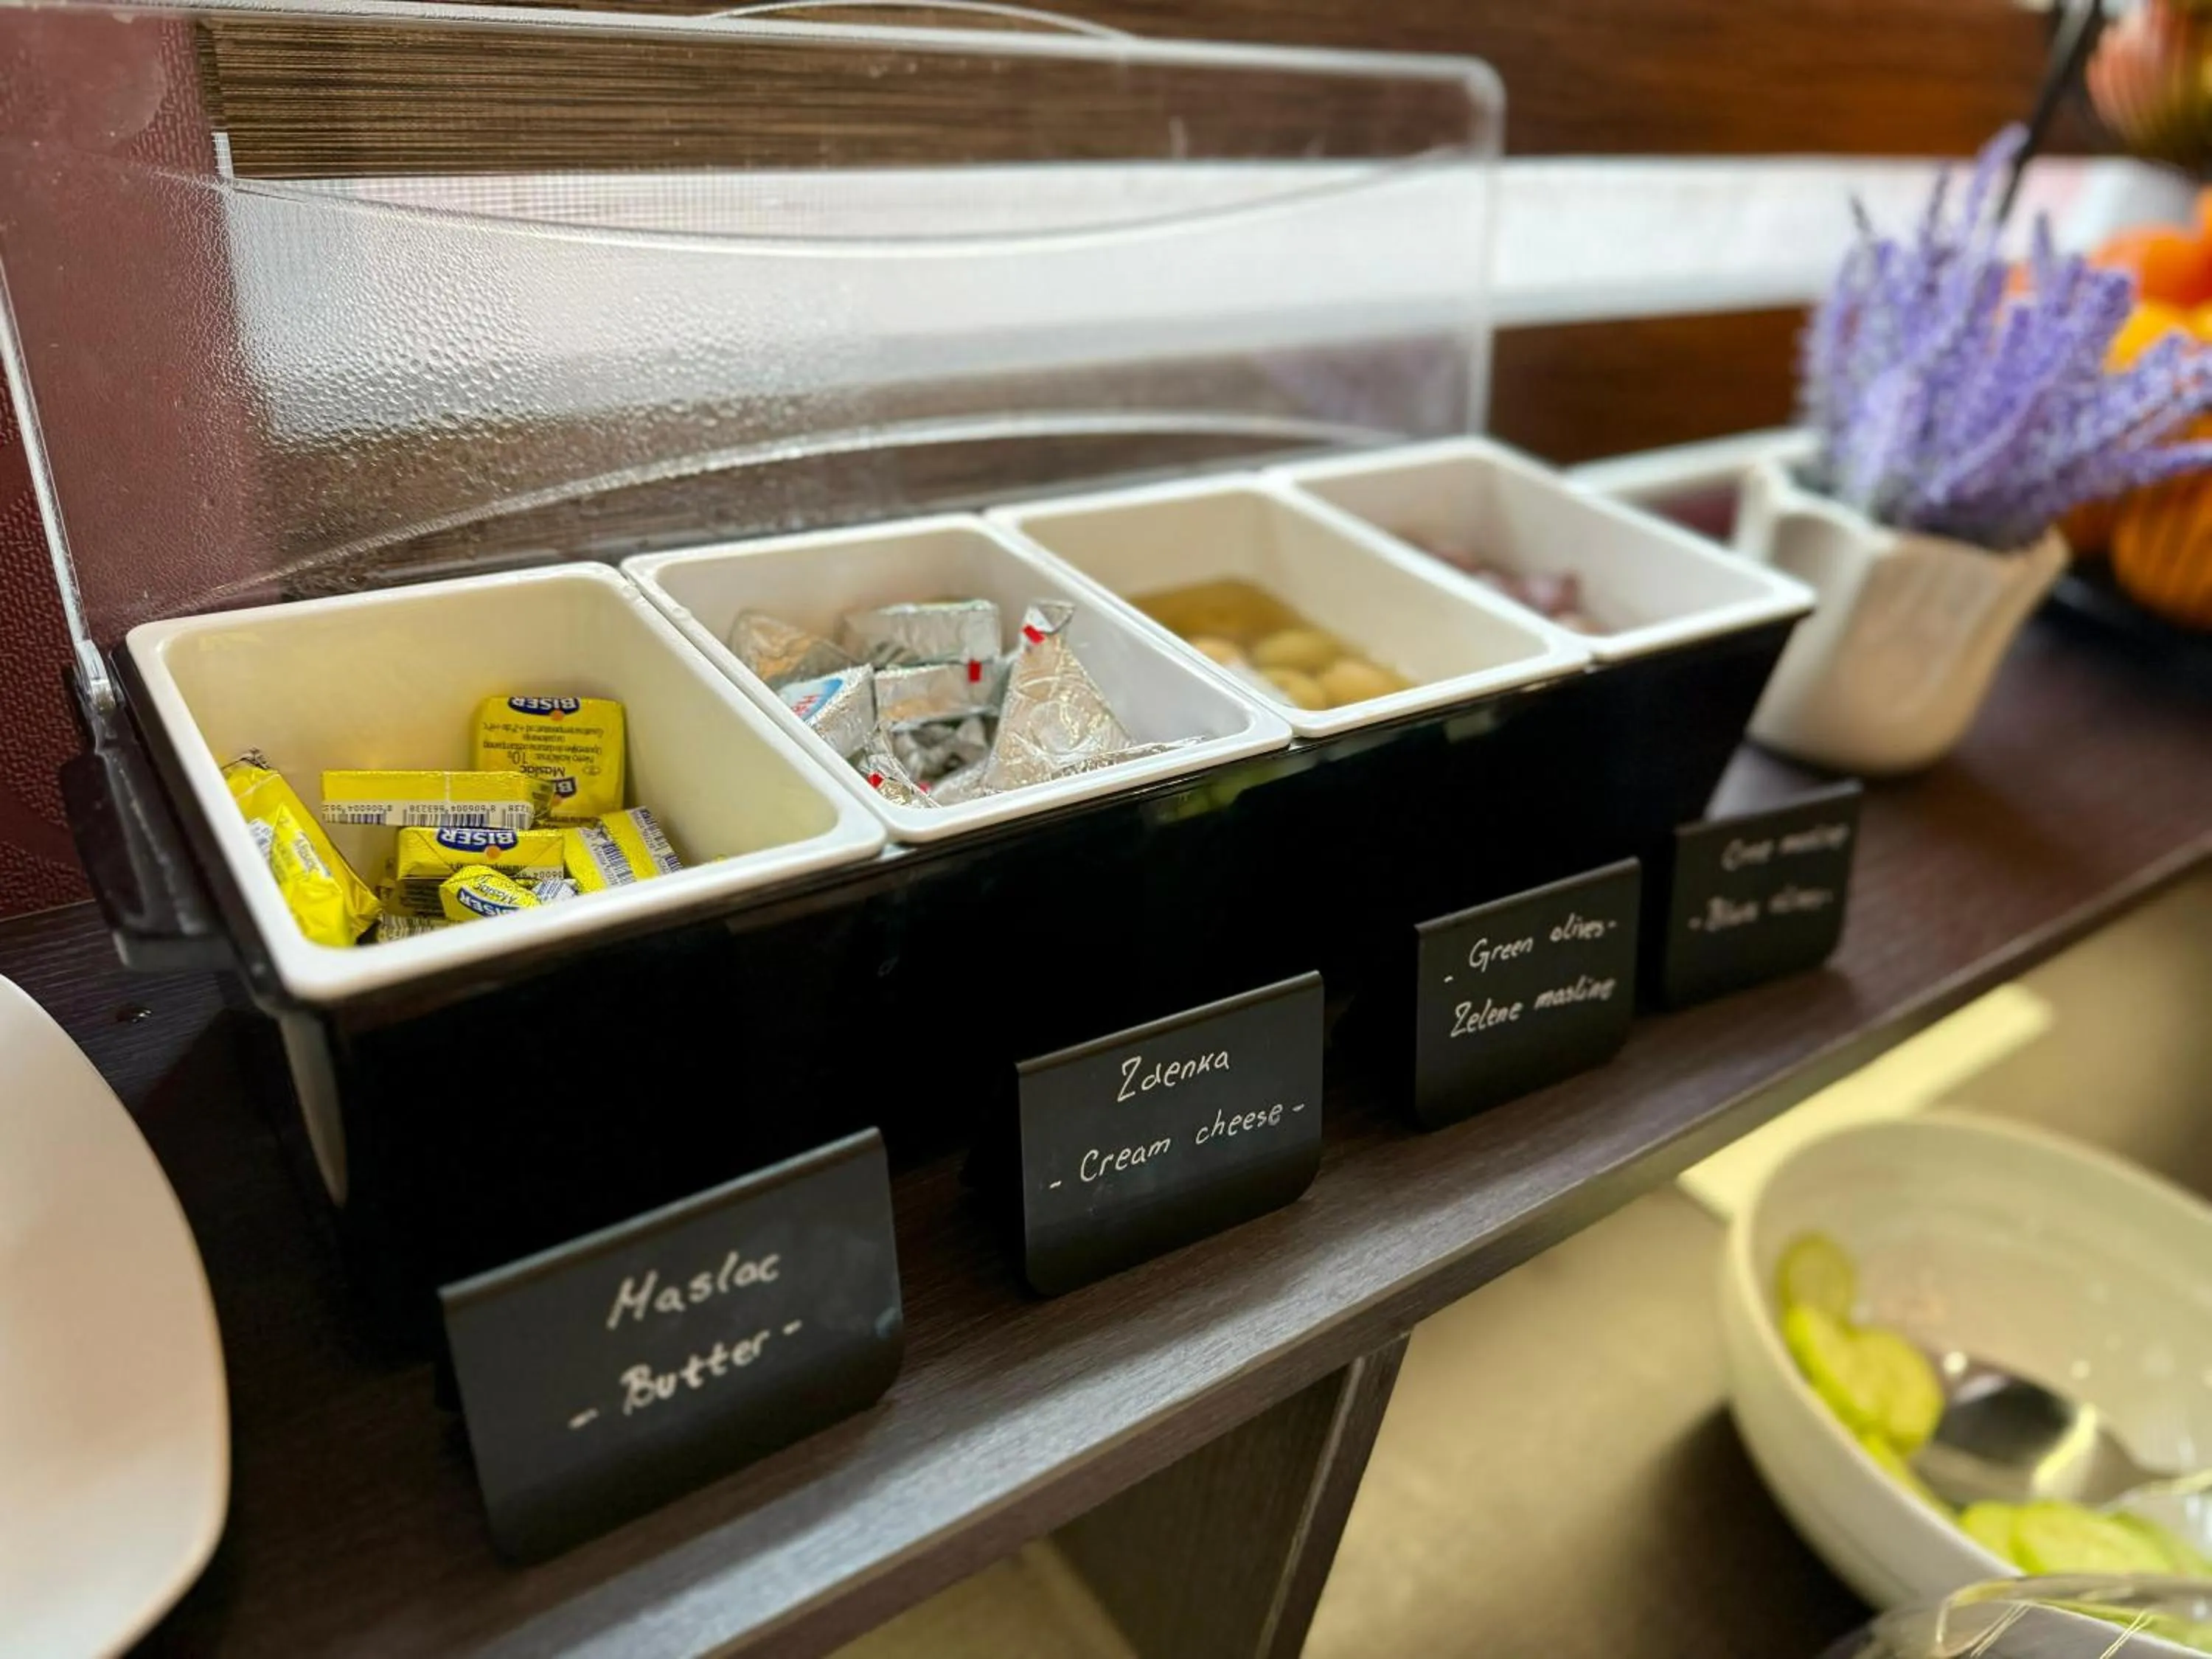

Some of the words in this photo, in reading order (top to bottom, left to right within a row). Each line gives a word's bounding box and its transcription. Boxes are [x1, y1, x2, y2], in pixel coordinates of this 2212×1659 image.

[440, 829, 515, 845] BISER
[1468, 937, 1534, 973] Green
[1450, 998, 1523, 1038] Zelene
[1533, 975, 1615, 1009] masline
[1116, 1050, 1230, 1102] Zdenka
[1079, 1138, 1172, 1182] Cream
[1194, 1104, 1284, 1145] cheese
[606, 1251, 781, 1329] Maslac
[619, 1329, 771, 1415] Butter
